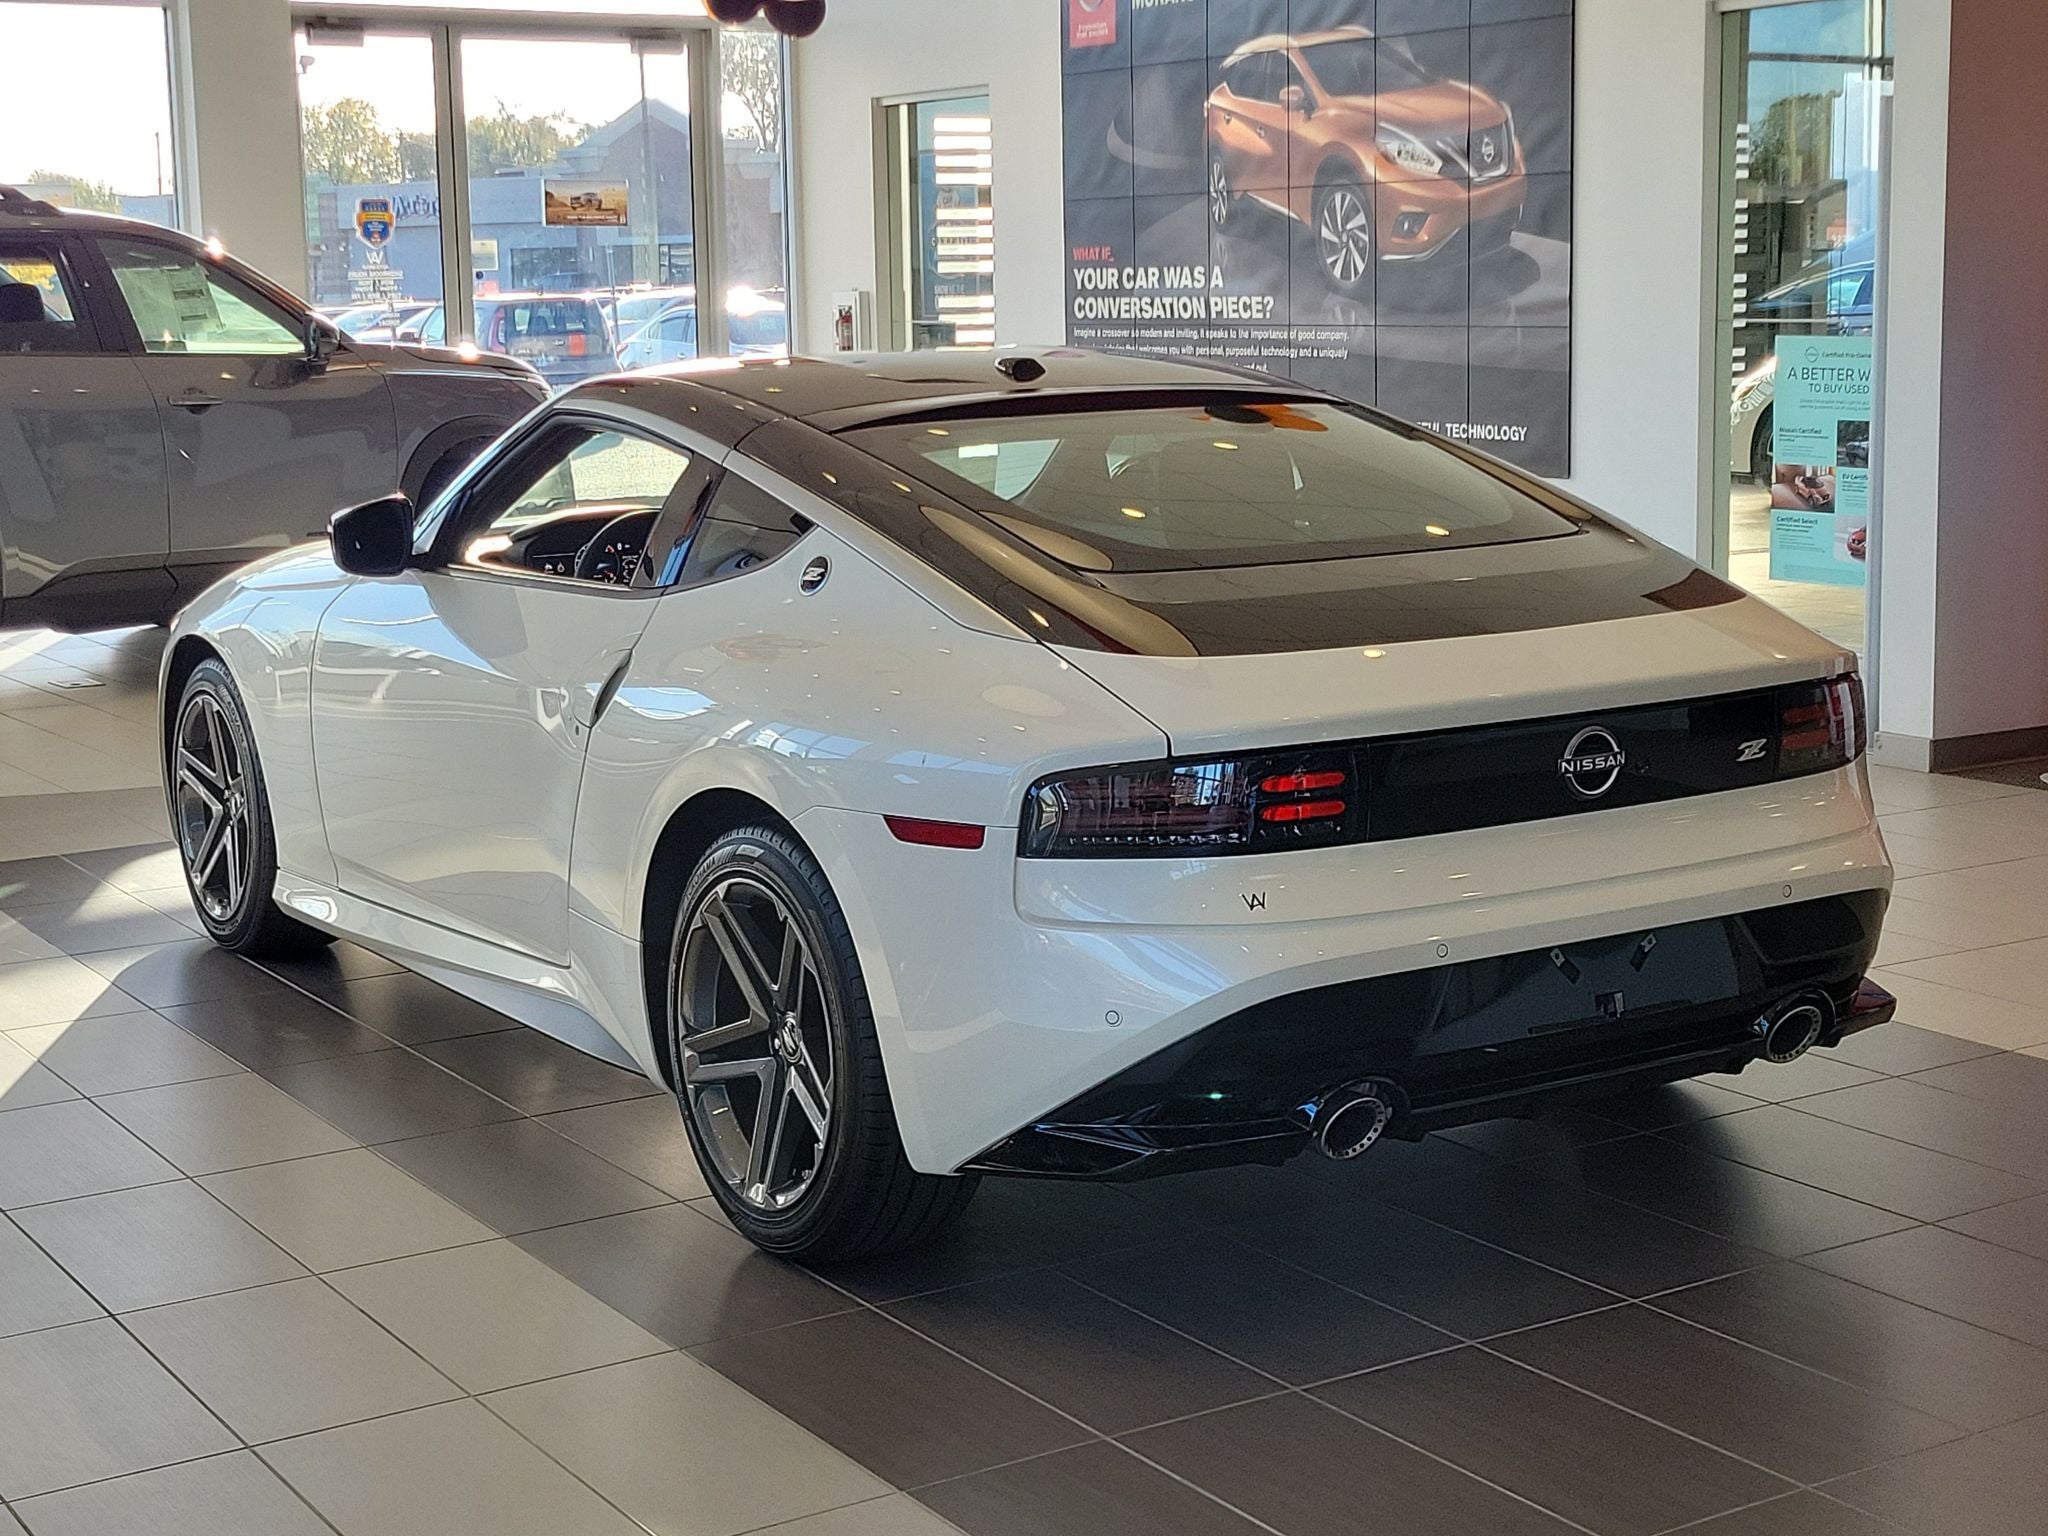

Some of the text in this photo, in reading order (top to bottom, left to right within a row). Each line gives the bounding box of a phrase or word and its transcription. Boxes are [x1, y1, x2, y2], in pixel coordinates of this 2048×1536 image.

[1072, 246, 1100, 261] WHAT
[1073, 265, 1224, 290] YOUR CAR WAS A
[1073, 295, 1274, 319] CONVERSATION PIECE?
[1073, 326, 1096, 340] Imagine
[1102, 328, 1131, 338] crossover
[1140, 328, 1163, 338] modern
[1163, 328, 1176, 338] and
[1206, 328, 1228, 341] speaks
[1230, 328, 1237, 339] to
[1238, 328, 1249, 339] the
[1250, 328, 1288, 341] importance
[1290, 328, 1297, 339] of
[1297, 329, 1315, 342] good
[1316, 330, 1350, 342] company.
[1168, 345, 1180, 356] you
[1180, 344, 1195, 355] with
[1195, 345, 1224, 358] personal,
[1225, 345, 1259, 358] purposeful
[1261, 345, 1298, 359] technology
[1299, 346, 1312, 358] and
[1313, 348, 1318, 358] a
[1319, 347, 1349, 360] uniquely
[1787, 367, 1798, 380] A
[1801, 367, 1854, 381] BETTER
[1808, 383, 1870, 394] TO BUY USED
[1445, 423, 1527, 441] TECHNOLOGY
[1735, 738, 1768, 762] Z
[1560, 751, 1626, 774] NISSAN
